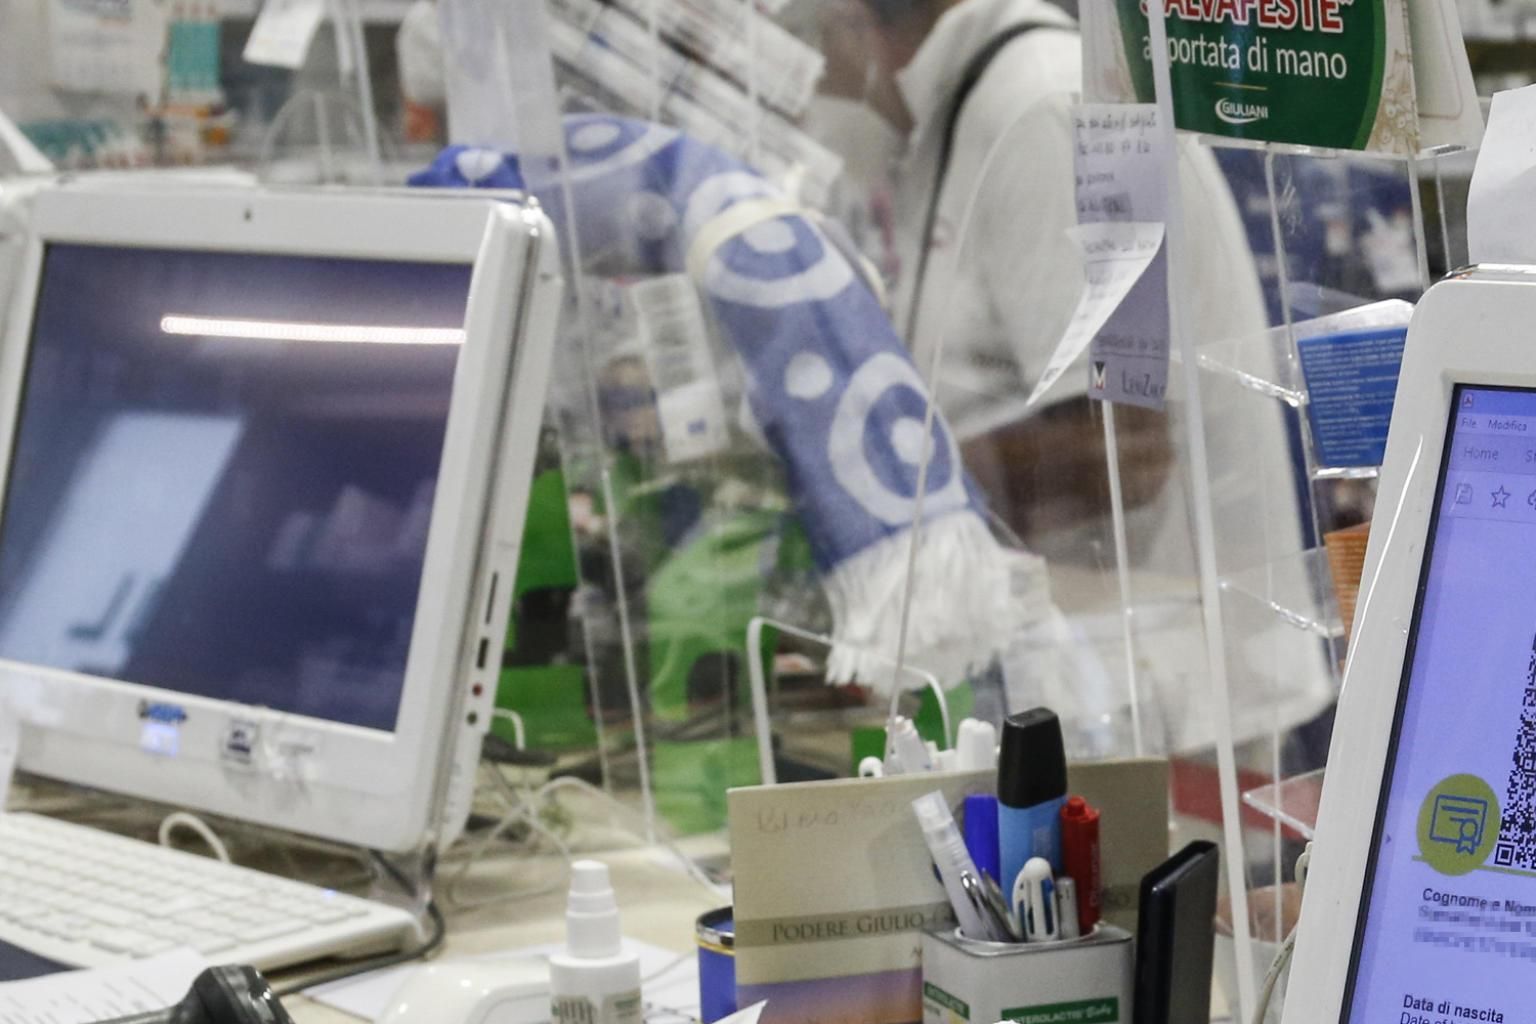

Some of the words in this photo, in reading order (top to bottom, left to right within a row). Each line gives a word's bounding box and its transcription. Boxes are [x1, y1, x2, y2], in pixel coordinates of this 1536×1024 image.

[1169, 36, 1241, 69] portata
[1247, 38, 1268, 72] di
[1276, 52, 1348, 80] mano
[1221, 100, 1269, 119] GIULIANI
[1488, 419, 1528, 432] Modifica
[1464, 446, 1499, 460] Home
[1422, 887, 1488, 909] Cognome
[772, 919, 850, 943] PODERE
[856, 911, 925, 935] GIULIO
[1403, 994, 1434, 1014] Data
[1437, 999, 1450, 1016] di
[1454, 1003, 1505, 1024] nascita
